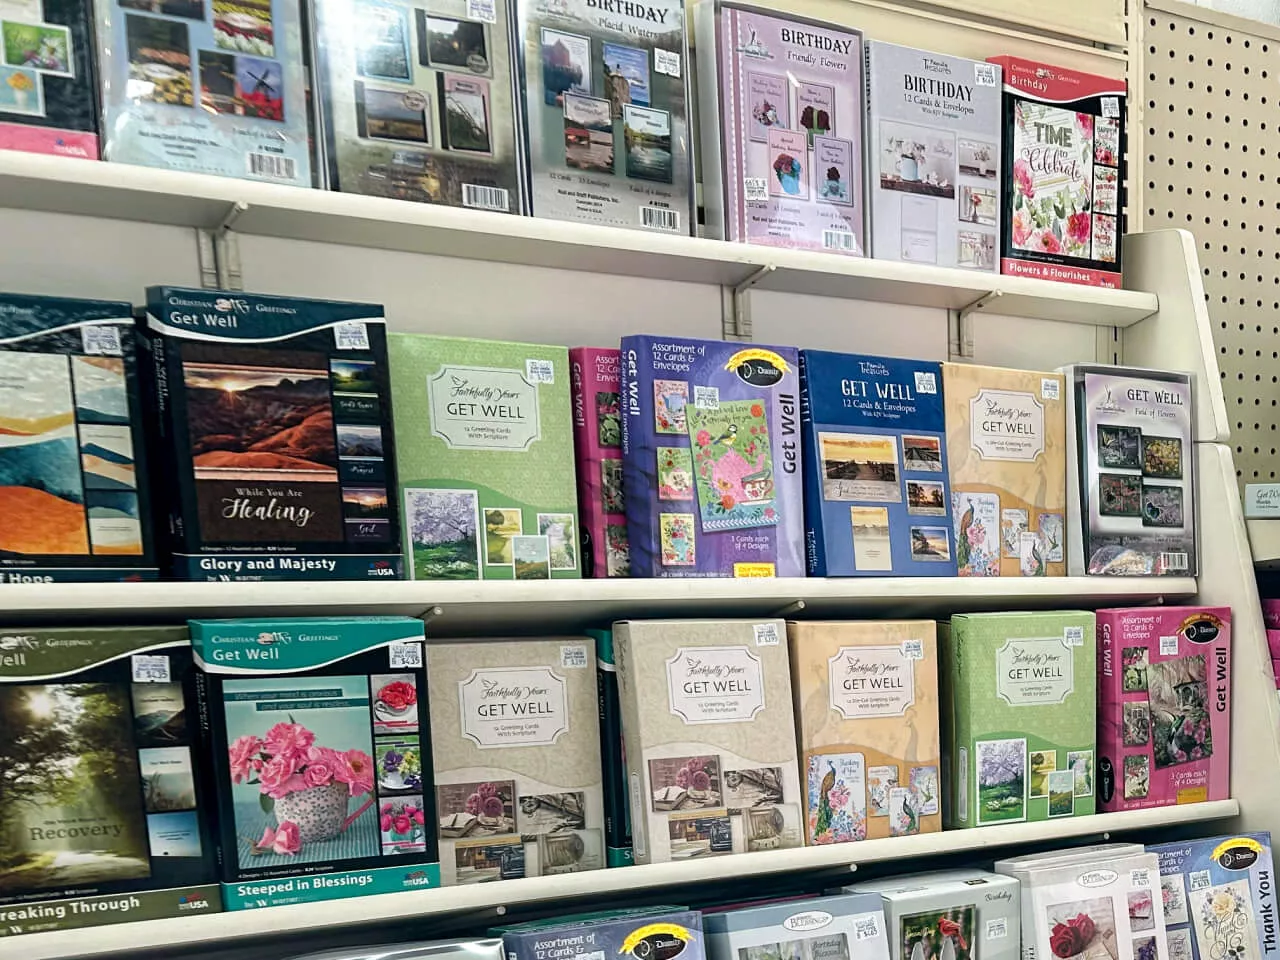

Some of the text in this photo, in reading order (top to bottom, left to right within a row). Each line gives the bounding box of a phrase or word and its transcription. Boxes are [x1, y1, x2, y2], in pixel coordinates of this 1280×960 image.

[586, 0, 669, 24] BIRTHDAY
[600, 19, 658, 39] Placid Waters
[781, 27, 852, 56] BIRTHDAY
[788, 51, 848, 71] Friendly Flowers
[904, 74, 974, 102] BIRTHDAY
[1011, 75, 1048, 92] Birthday
[904, 94, 975, 115] 12 Cards Envelopes
[1033, 121, 1072, 148] TIME
[1022, 147, 1082, 179] Celebrate
[1009, 262, 1090, 281] Flowers & Flourishes
[170, 312, 238, 329] Get Well
[652, 342, 705, 356] Assortment of
[653, 353, 686, 363] 12 Cards
[653, 361, 690, 373] Envelopes
[627, 349, 641, 417] Get Well
[841, 379, 914, 402] GET WELL
[450, 384, 521, 401] Faithfully Yours
[1127, 388, 1183, 406] GET WELL
[446, 403, 525, 419] GET WELL
[843, 399, 916, 414] 12 Cards Envelopes
[782, 393, 797, 474] Get Well
[982, 420, 1035, 436] GET WELL
[235, 487, 302, 498] While You Are
[221, 498, 315, 527] Healing
[200, 557, 336, 573] Glory and Majesty
[377, 567, 394, 577] USA
[212, 647, 279, 662] Get Well
[1008, 665, 1063, 680] GET WELL
[1214, 646, 1228, 713] Get Well
[683, 679, 752, 694] GET WELL
[843, 676, 903, 691] GET WELL
[477, 702, 554, 718] GET WELL
[30, 823, 123, 843] Recovery
[238, 873, 373, 897] Steeped in Blessings
[411, 876, 429, 886] USA
[0, 896, 140, 921] reaking Through
[190, 900, 208, 908] USA
[1257, 870, 1276, 955] Thank You
[534, 933, 596, 952] Assortment of
[535, 948, 574, 959] 12 Cards
